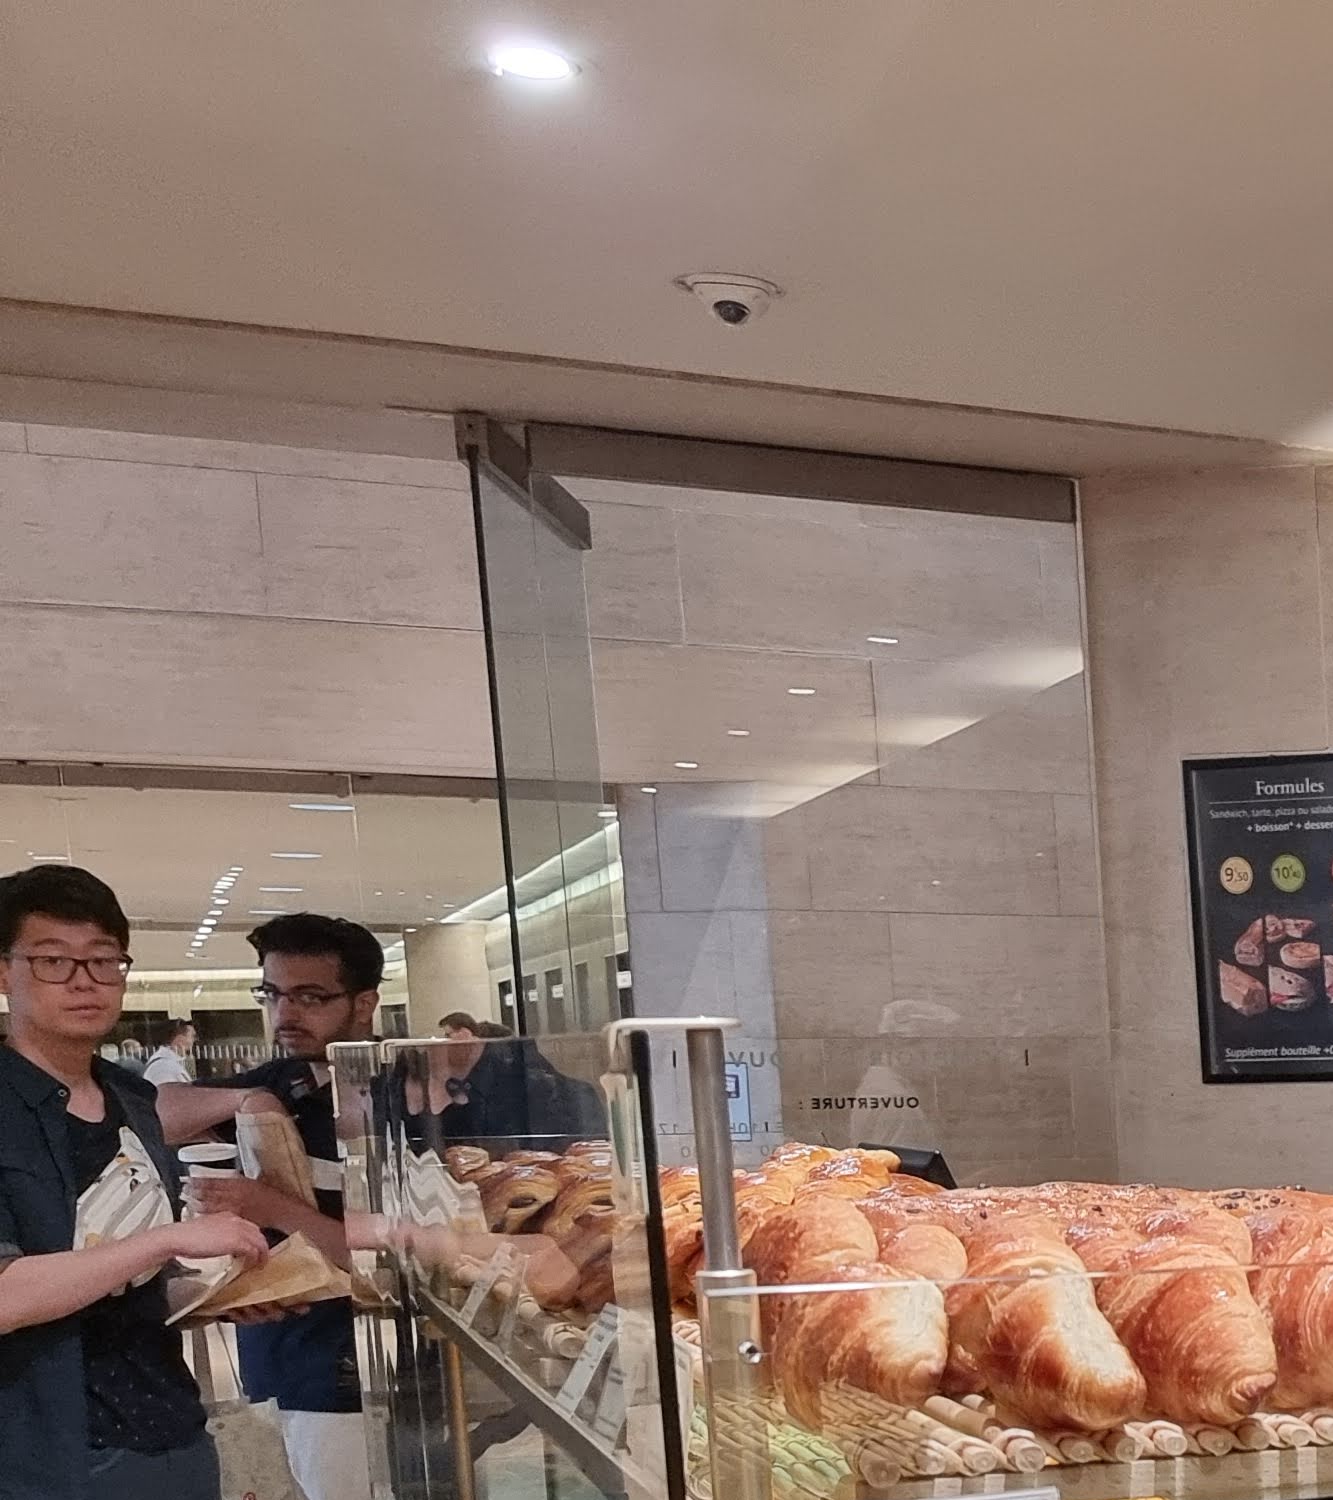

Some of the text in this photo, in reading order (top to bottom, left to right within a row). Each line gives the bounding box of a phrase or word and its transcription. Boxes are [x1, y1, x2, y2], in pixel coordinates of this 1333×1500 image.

[1255, 777, 1325, 796] Formules
[1275, 808, 1295, 818] pizza
[1225, 1045, 1278, 1058] Supplément
[1281, 1044, 1321, 1056] bouteille
